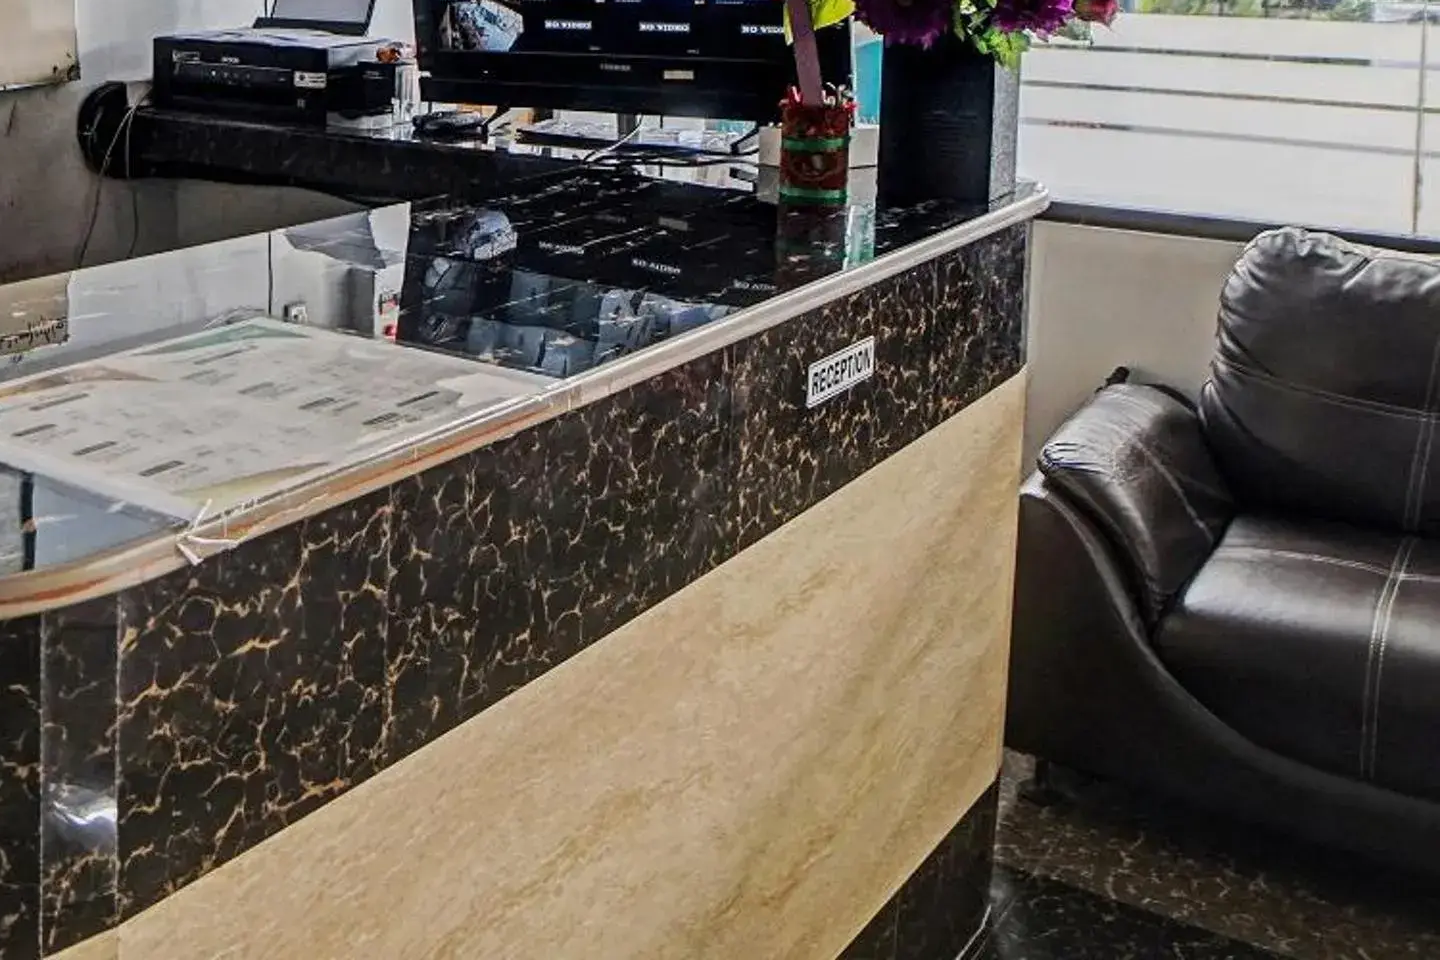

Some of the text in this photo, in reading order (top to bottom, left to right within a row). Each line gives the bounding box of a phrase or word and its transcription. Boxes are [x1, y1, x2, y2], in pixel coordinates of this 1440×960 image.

[656, 23, 690, 33] VIDEO
[741, 24, 758, 33] NO
[812, 347, 871, 396] RECEPTION
